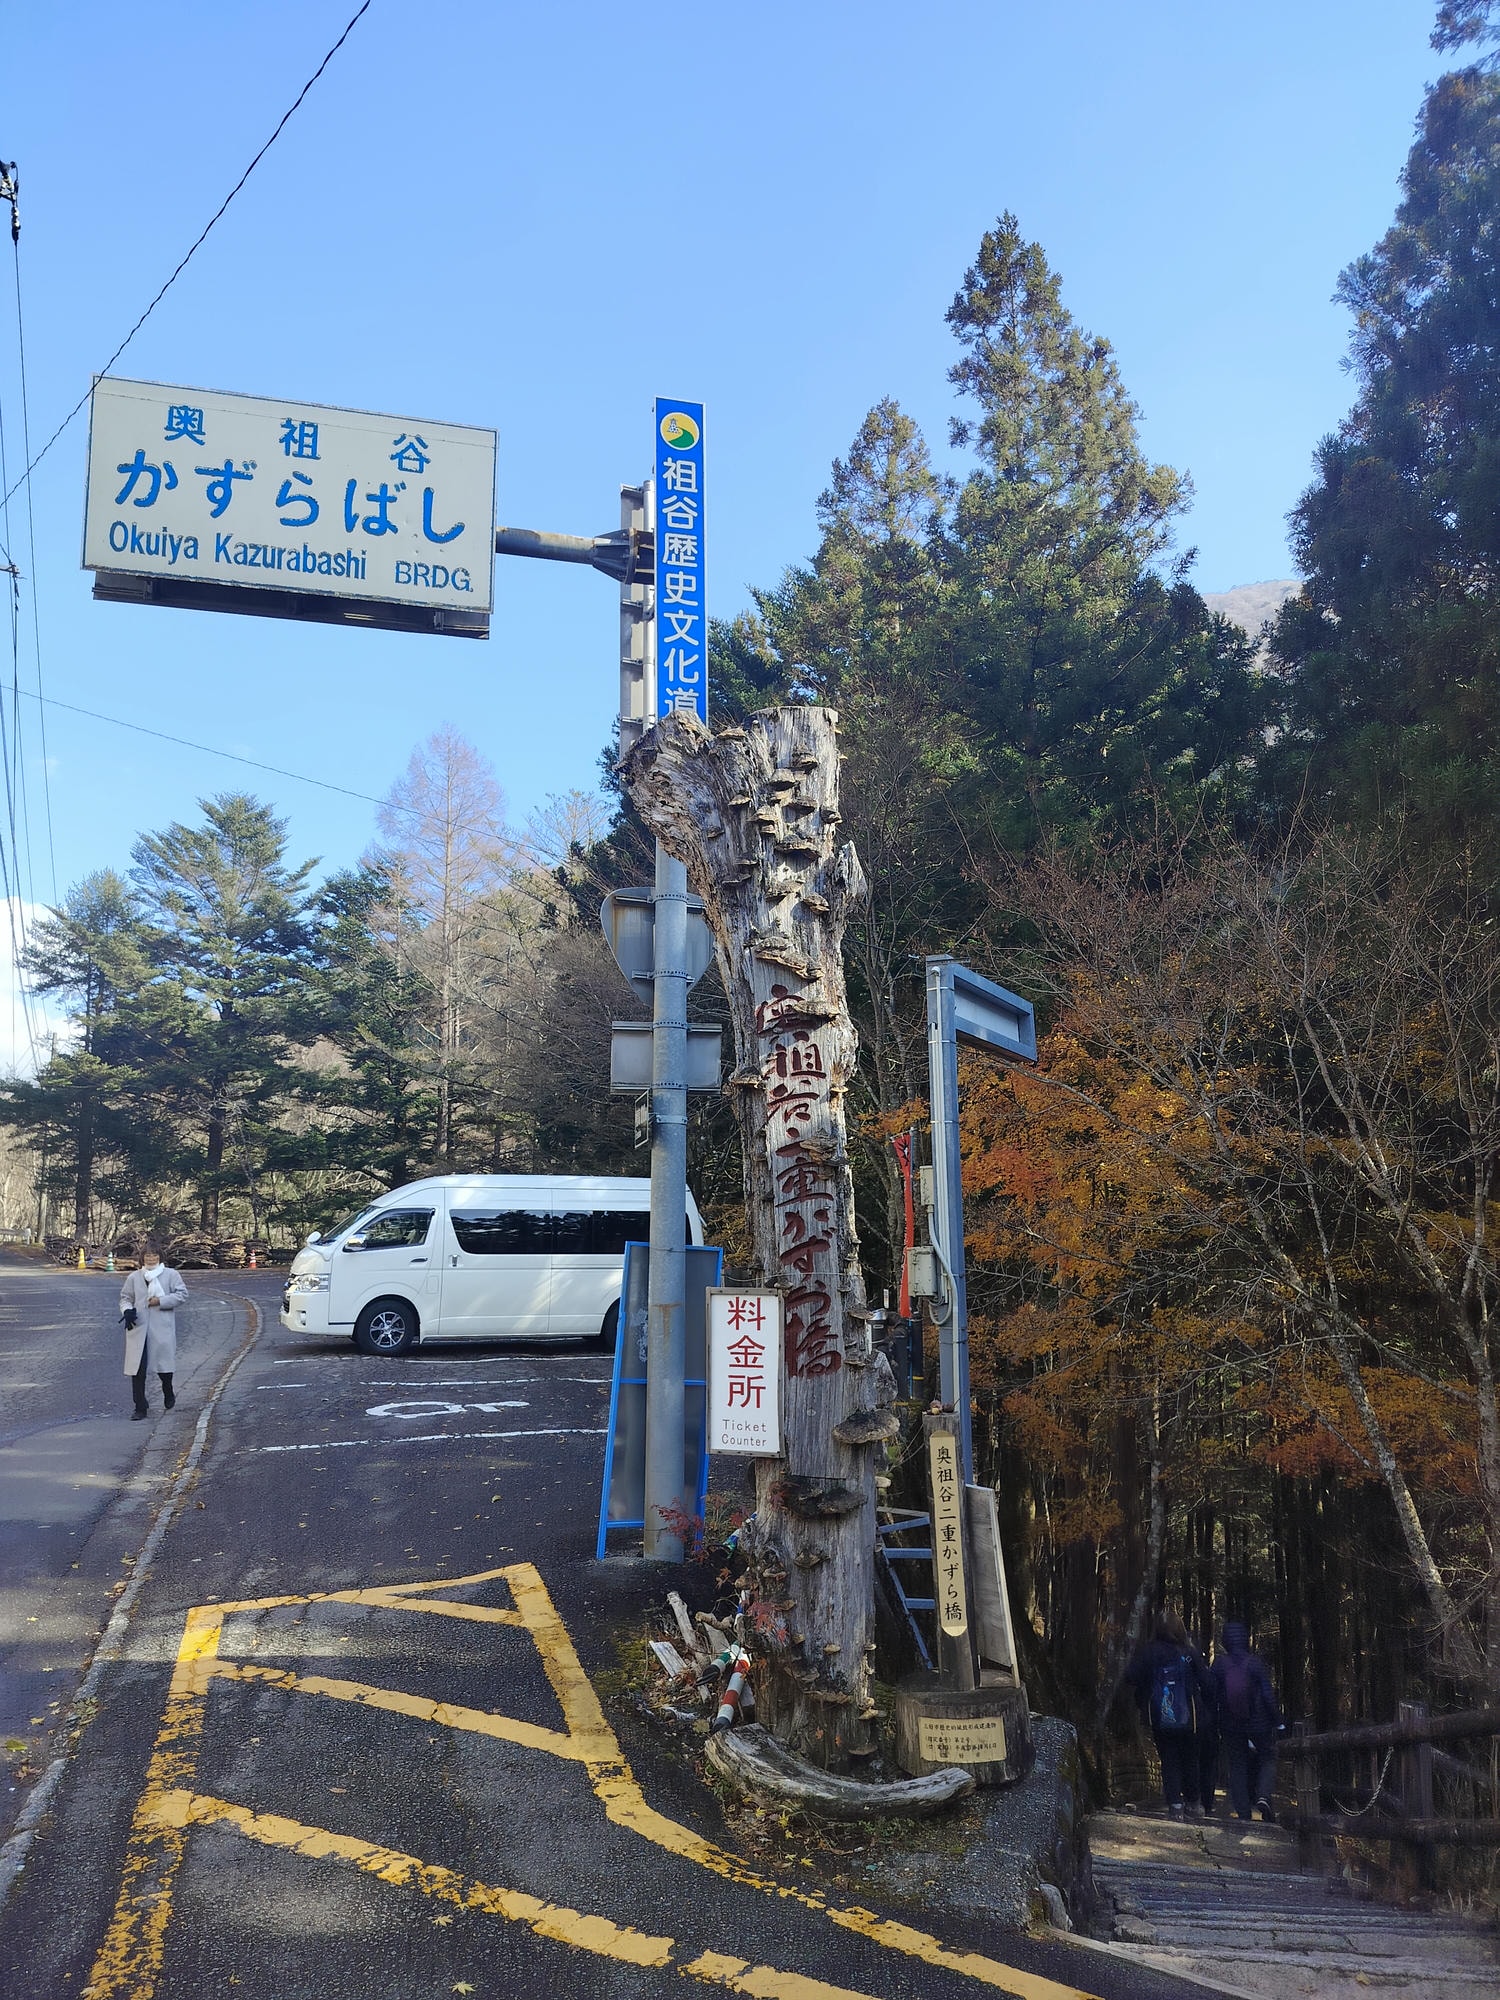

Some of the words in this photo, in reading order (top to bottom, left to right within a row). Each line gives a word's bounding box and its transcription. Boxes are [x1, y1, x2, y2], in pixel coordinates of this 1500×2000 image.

[164, 405, 431, 474] 奥祖谷
[115, 449, 465, 544] かずらばし
[109, 520, 199, 565] Okuiya
[214, 532, 367, 580] Kazurabashi
[727, 1296, 766, 1409] 料金所
[721, 1433, 767, 1447] Counter
[722, 1419, 767, 1433] Ticket
[936, 1445, 963, 1621] 奥祖谷二重かずら橋
